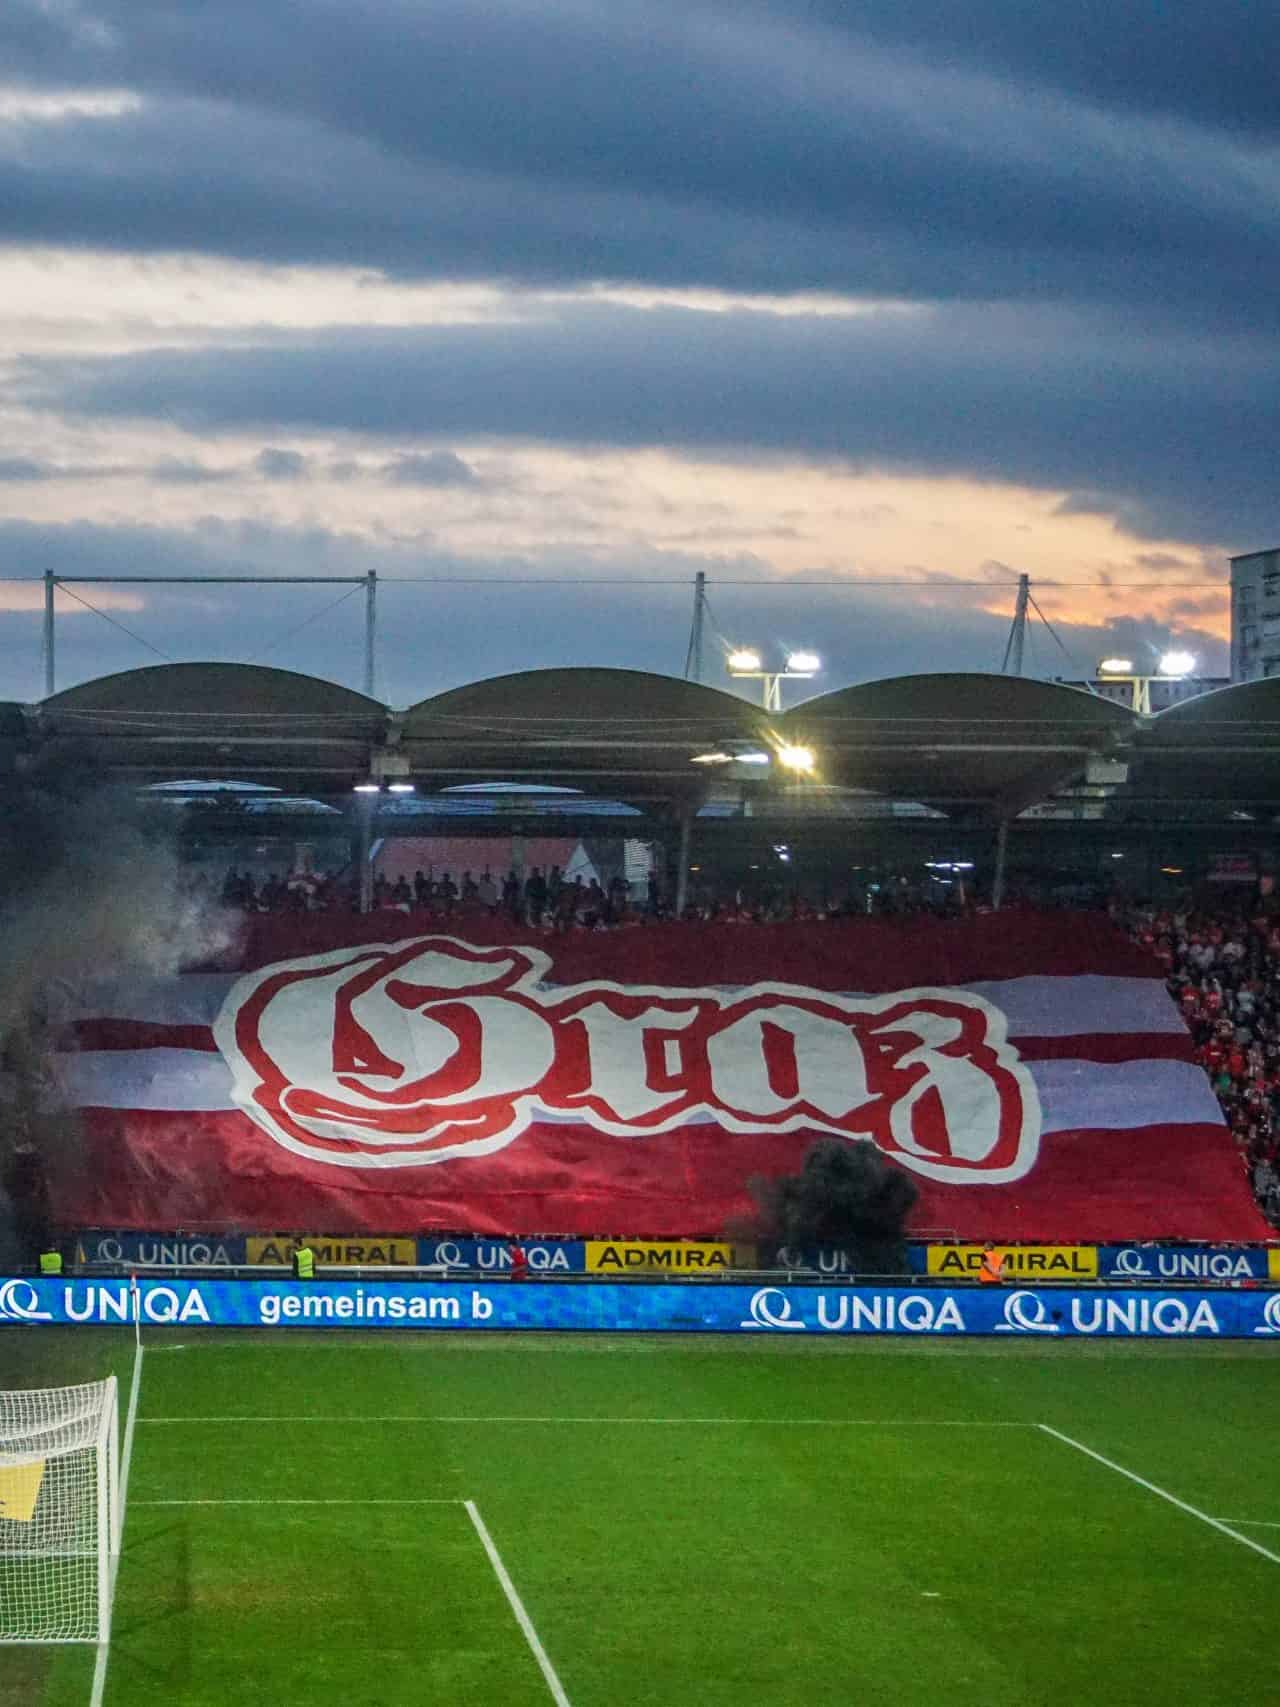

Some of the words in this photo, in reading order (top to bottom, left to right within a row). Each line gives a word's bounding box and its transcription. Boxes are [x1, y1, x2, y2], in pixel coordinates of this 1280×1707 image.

[213, 936, 1041, 1185] Graz
[138, 1243, 231, 1266] UNIQA
[1158, 1253, 1254, 1277] UNIQA
[65, 1287, 211, 1322] UNIQA
[259, 1289, 460, 1324] gemeinsam
[472, 1290, 493, 1319] b
[817, 1295, 966, 1330] UNIQA
[1071, 1298, 1220, 1333] UNIQA
